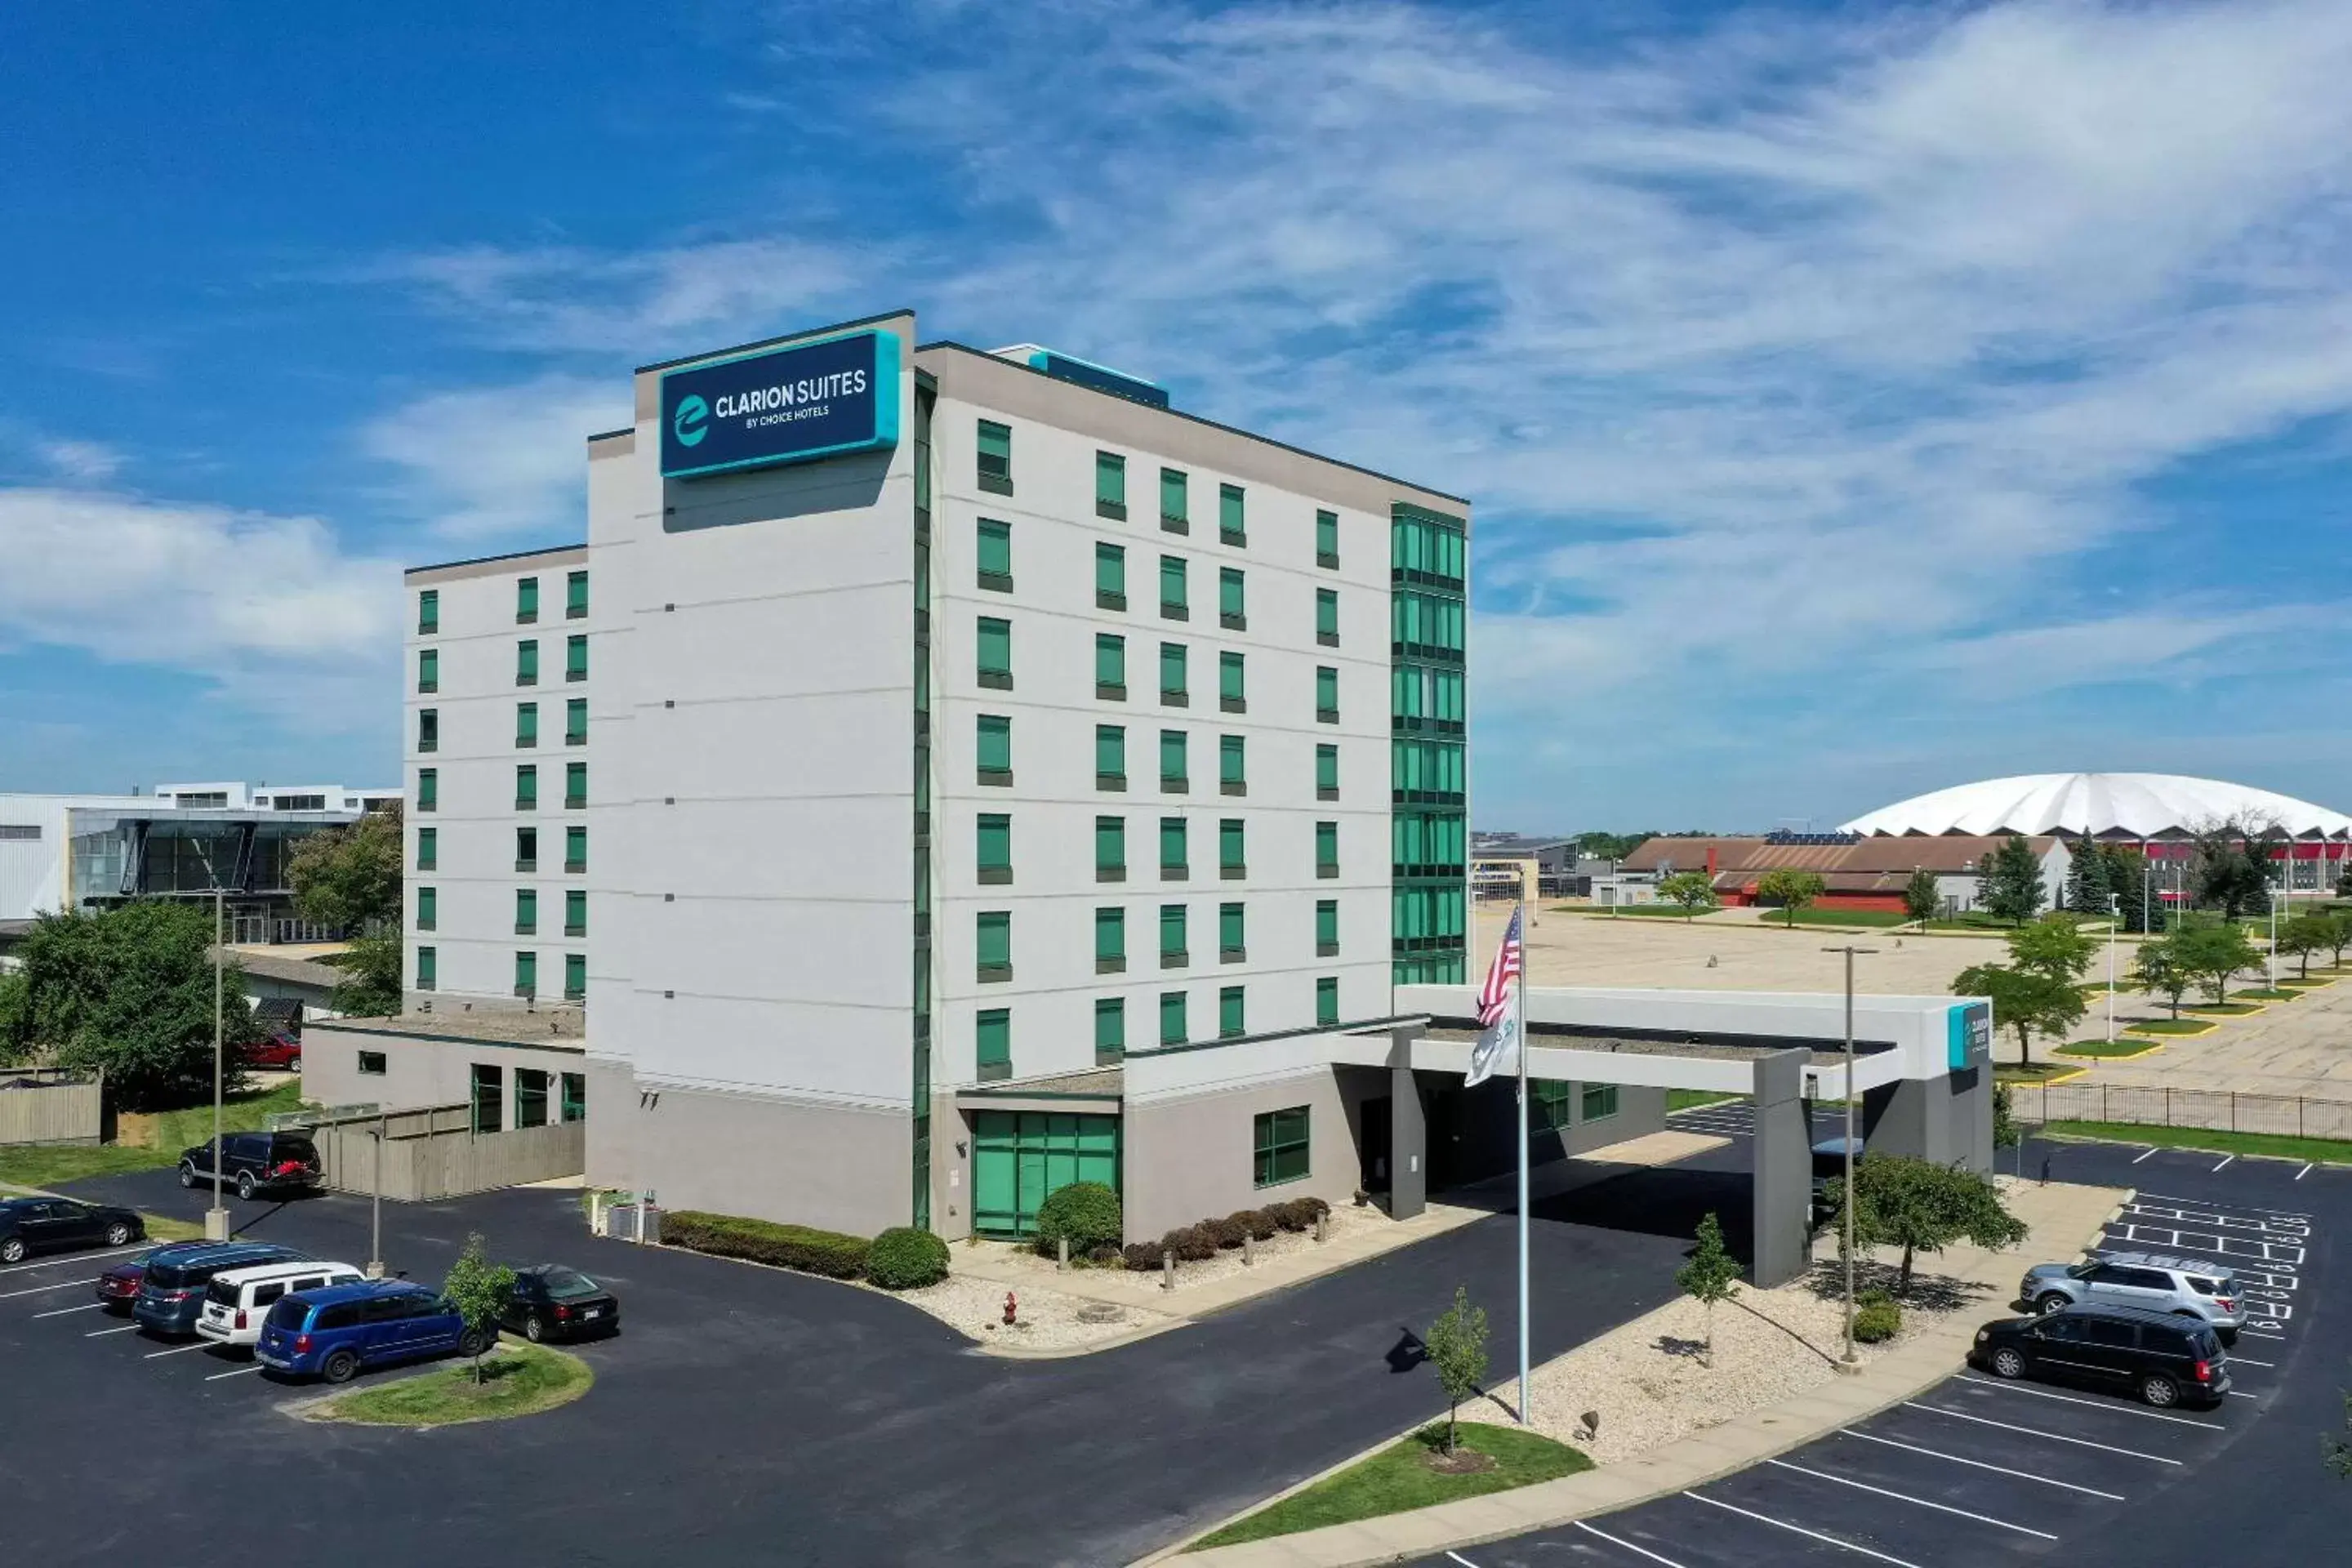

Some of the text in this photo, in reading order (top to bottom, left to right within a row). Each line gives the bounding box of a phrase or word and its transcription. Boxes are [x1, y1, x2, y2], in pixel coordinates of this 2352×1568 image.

[715, 369, 866, 418] CLARION SUITES
[746, 405, 830, 430] BY CHOICE HOTELS
